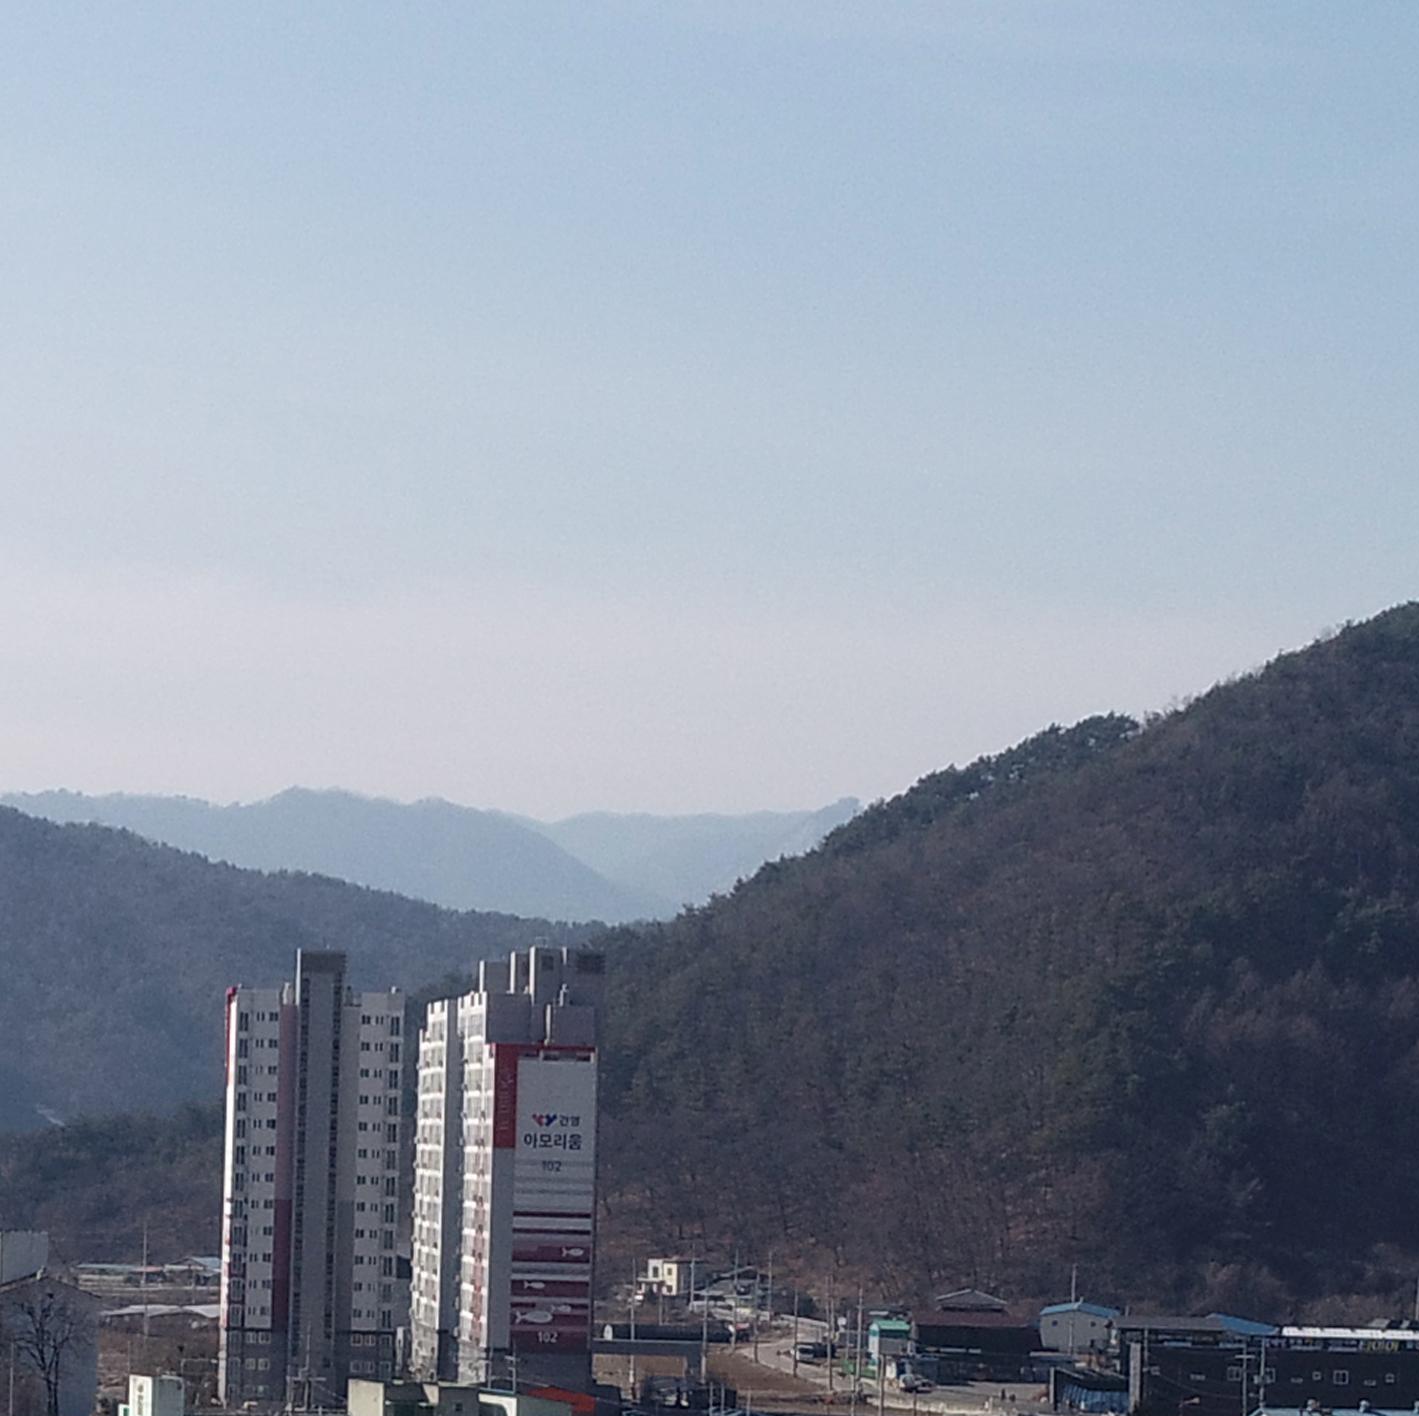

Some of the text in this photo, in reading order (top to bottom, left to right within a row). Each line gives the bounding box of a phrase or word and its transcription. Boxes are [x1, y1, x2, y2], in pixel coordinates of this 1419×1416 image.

[523, 1133, 582, 1150] 아모리움
[541, 1160, 562, 1172] 102
[538, 1331, 558, 1343] 102
